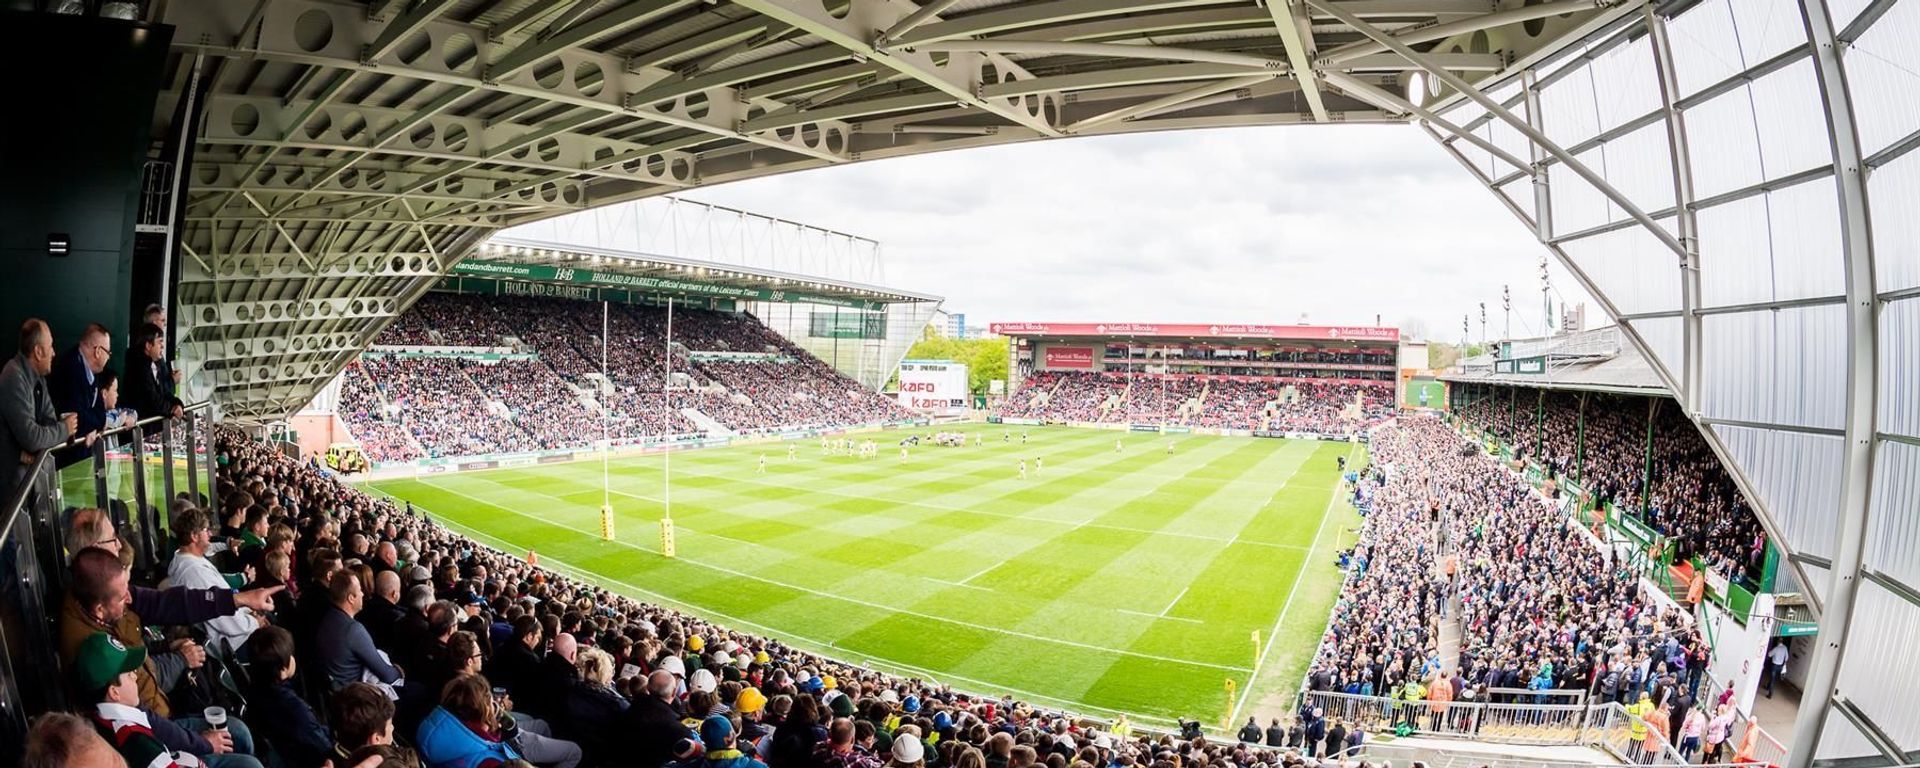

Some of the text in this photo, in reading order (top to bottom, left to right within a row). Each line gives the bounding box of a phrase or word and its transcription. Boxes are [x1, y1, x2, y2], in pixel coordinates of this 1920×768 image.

[592, 273, 624, 284] HOLLAND
[631, 276, 660, 287] BARRETT
[658, 280, 680, 289] official
[504, 281, 592, 299] HOLLAND & BARRETT
